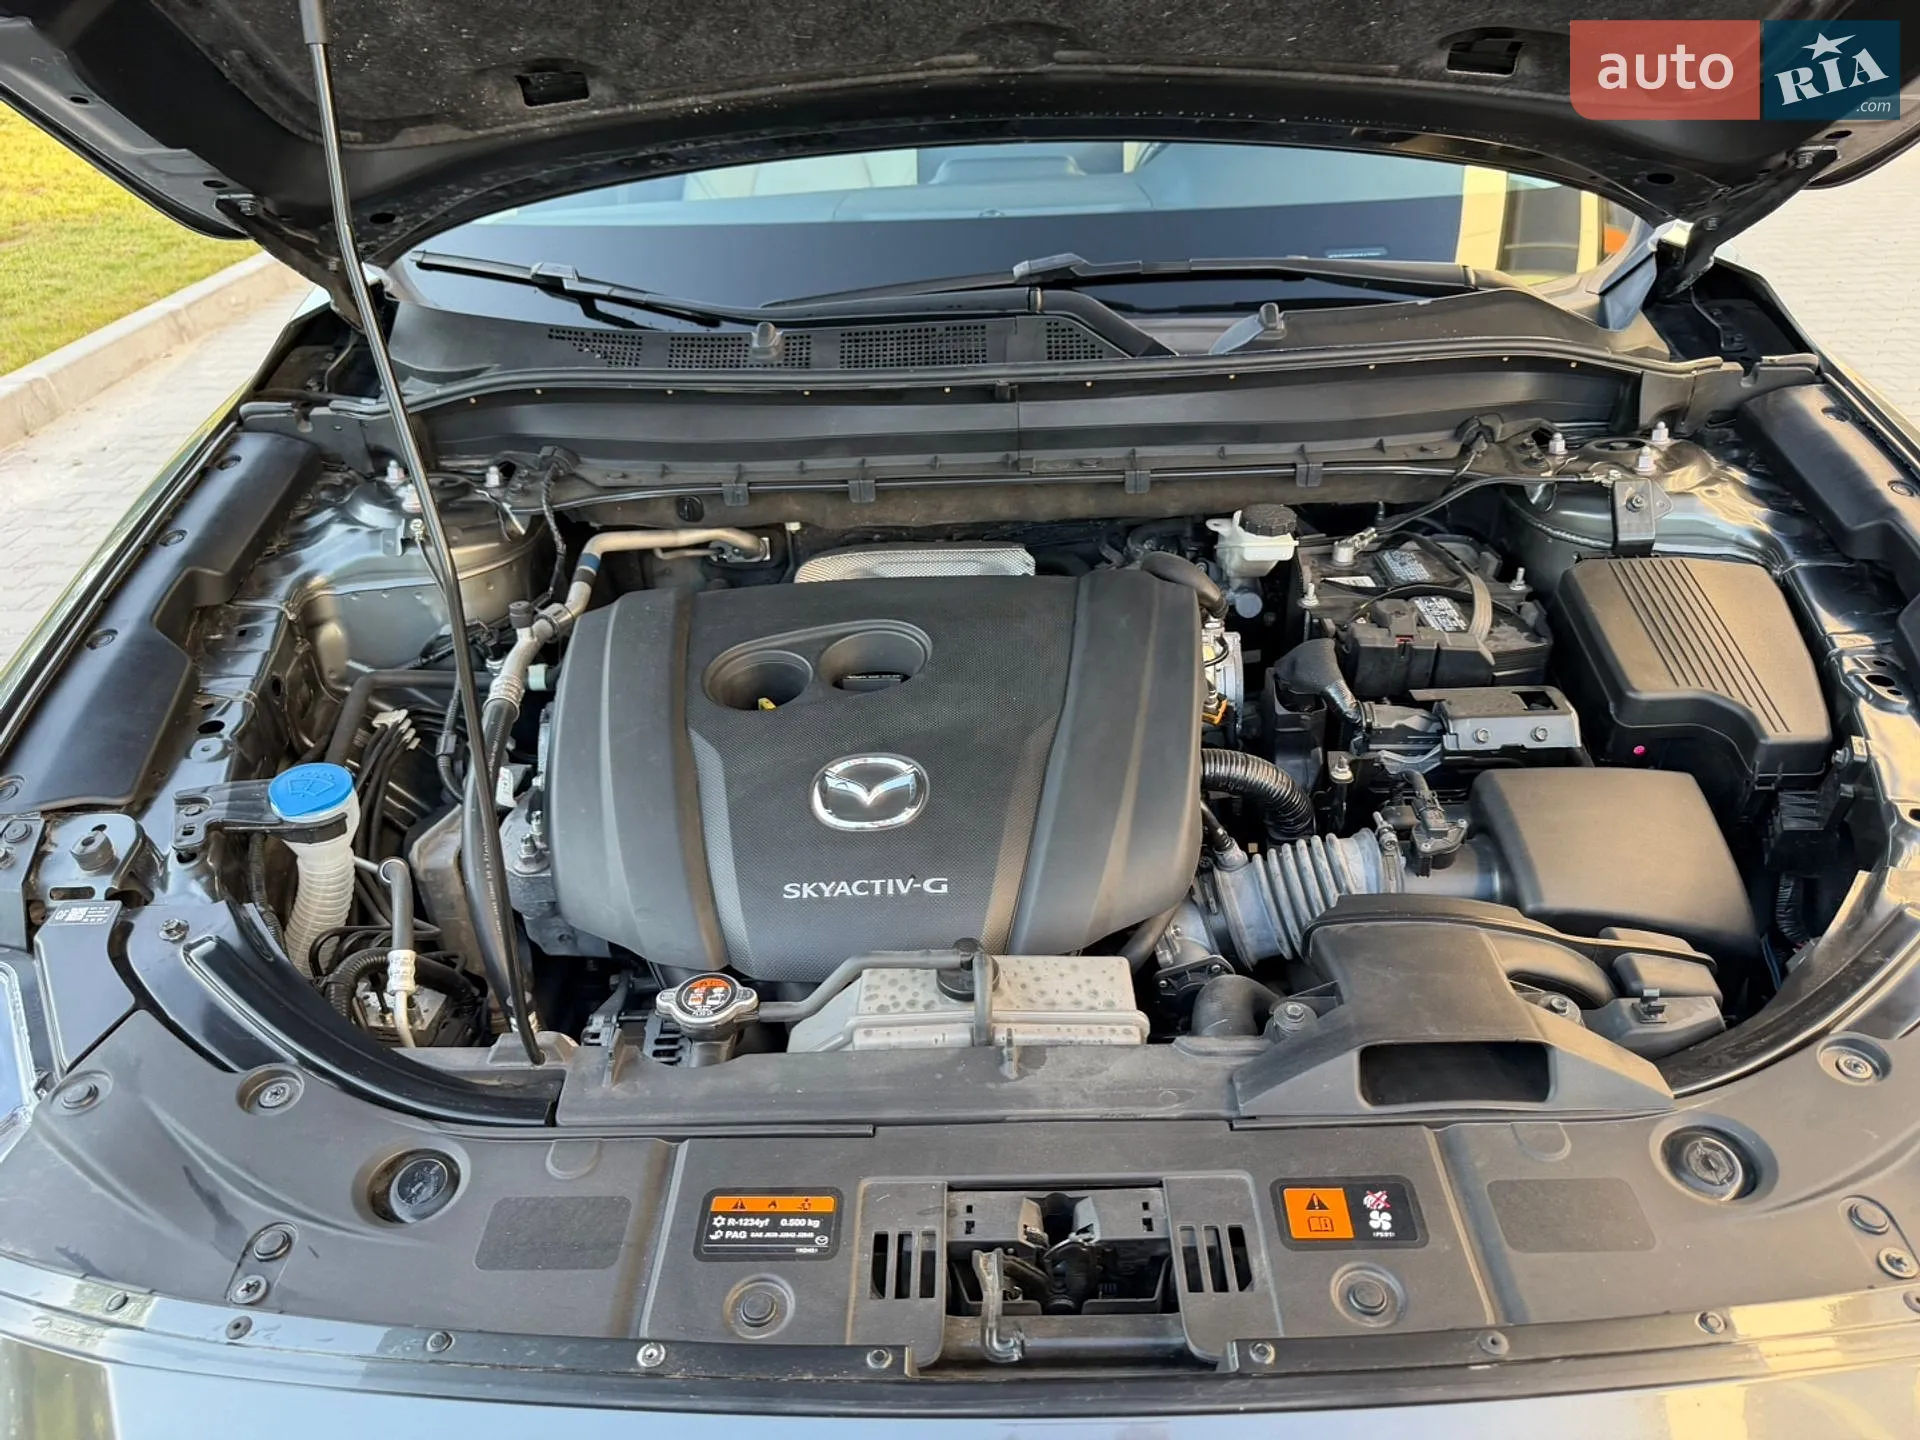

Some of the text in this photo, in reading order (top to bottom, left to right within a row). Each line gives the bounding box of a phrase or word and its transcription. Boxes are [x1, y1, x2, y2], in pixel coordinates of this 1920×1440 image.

[783, 877, 948, 899] SKYACTIV-G
[727, 1217, 770, 1228] R-1234yf
[808, 1217, 820, 1228] kg
[725, 1230, 747, 1239] PAG
